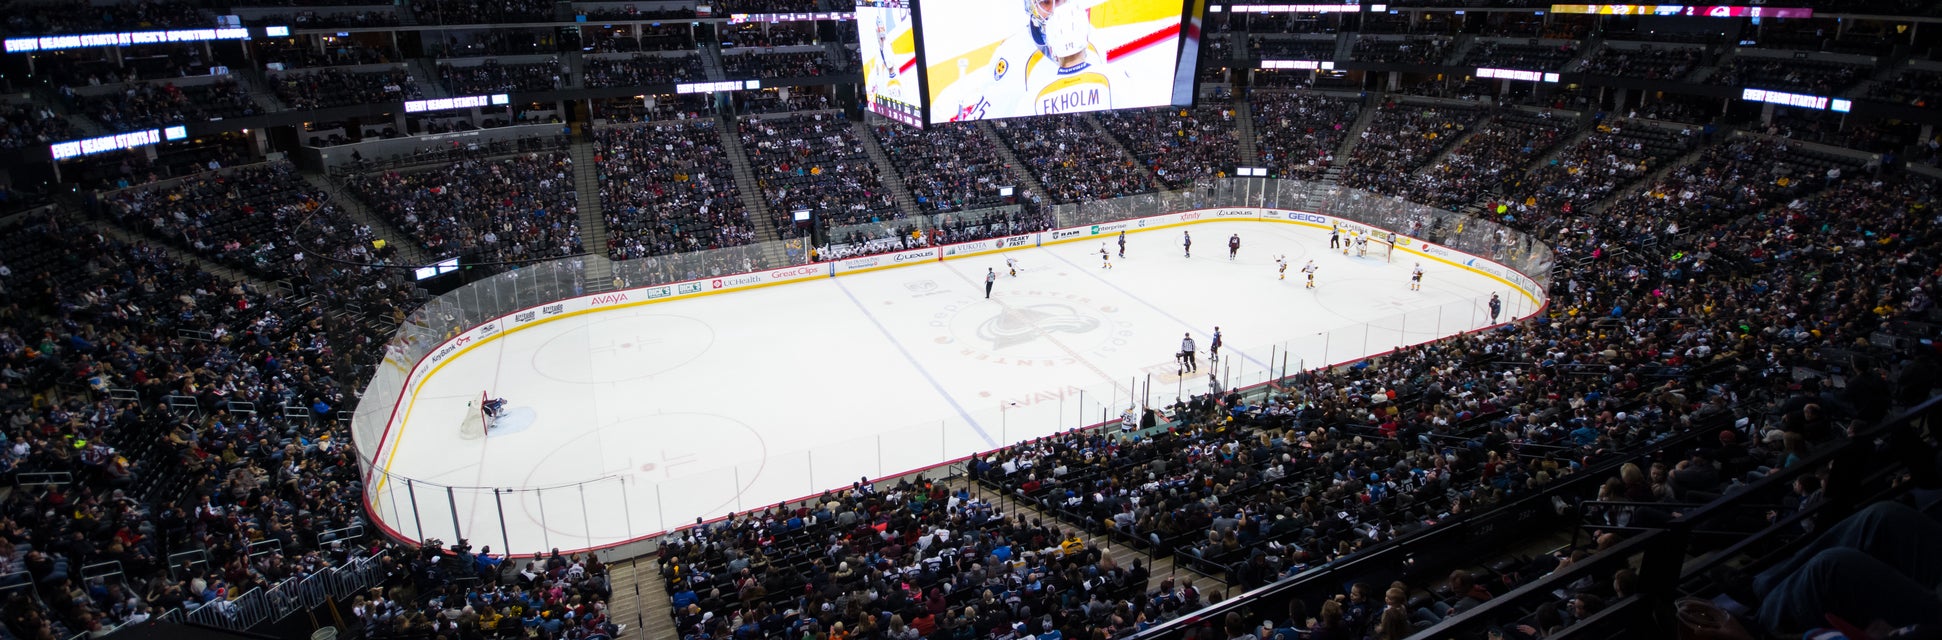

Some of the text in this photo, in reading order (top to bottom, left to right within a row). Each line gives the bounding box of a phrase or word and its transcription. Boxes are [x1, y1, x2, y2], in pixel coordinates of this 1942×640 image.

[1686, 6, 1694, 15] 2
[5, 38, 38, 52] EVERY
[39, 36, 81, 49] SEASON
[81, 34, 118, 46] STARTS
[119, 33, 131, 44] AT
[1043, 89, 1100, 114] EKHOLM
[51, 141, 81, 159] EVERY
[81, 136, 117, 154] SEASON
[116, 131, 149, 148] STARTS
[149, 129, 160, 143] AT
[1180, 212, 1201, 222] xfinity
[1289, 212, 1326, 224] GEICO
[1006, 235, 1029, 243] FREAKY
[957, 242, 987, 251] VUKOTA
[905, 251, 933, 260] LEXUS
[771, 266, 818, 279] Great Clips
[723, 275, 761, 288] UCHealth
[591, 293, 628, 306] AVAYA
[431, 343, 456, 364] KeyBank
